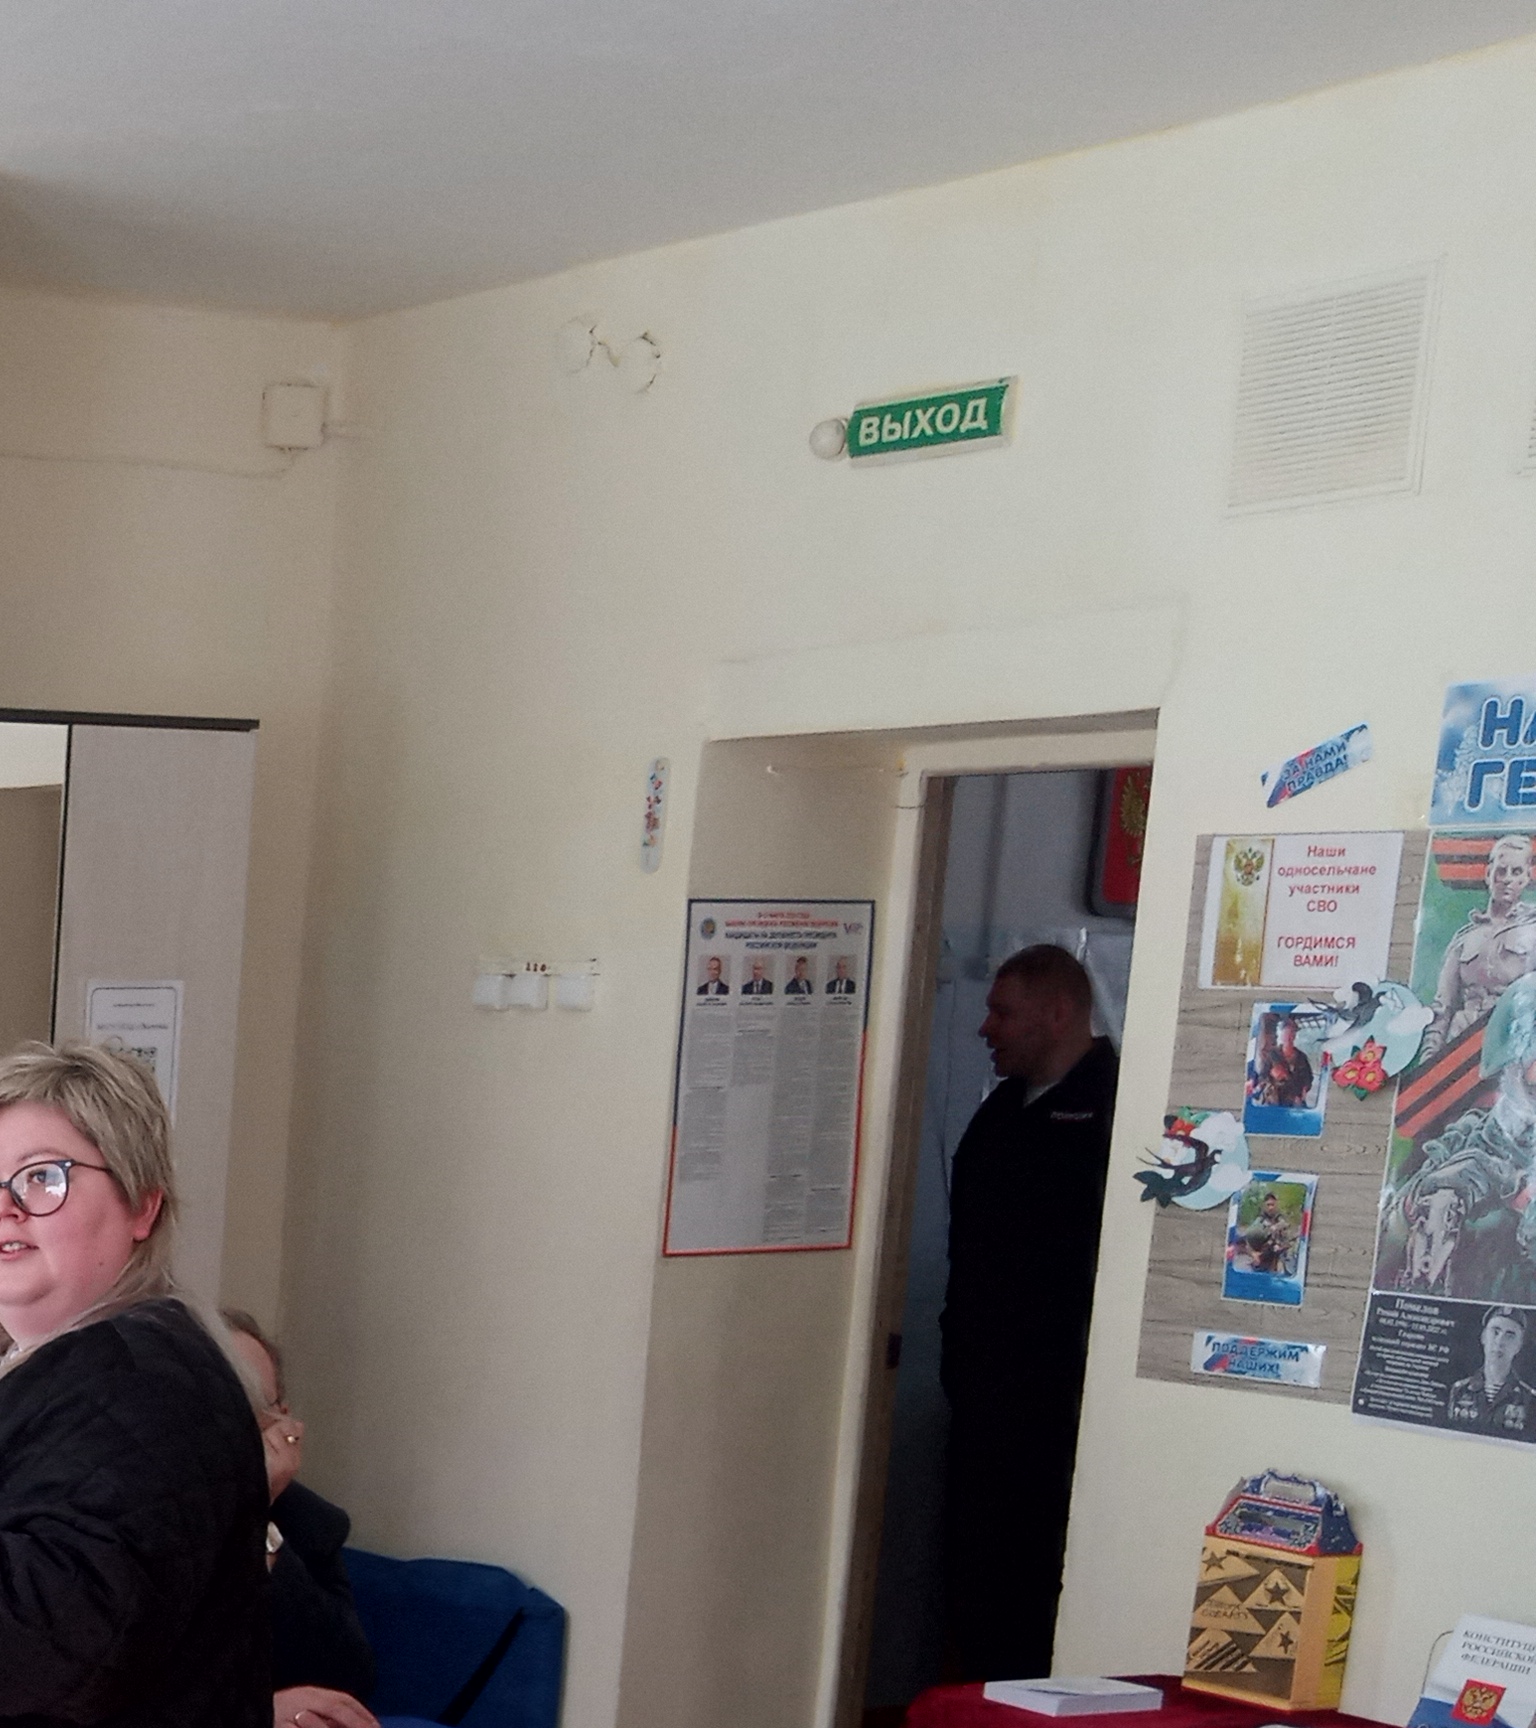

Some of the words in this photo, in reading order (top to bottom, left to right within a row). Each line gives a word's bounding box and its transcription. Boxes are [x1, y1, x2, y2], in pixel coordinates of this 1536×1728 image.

[858, 397, 989, 448] ВЫХОД
[1283, 764, 1301, 781] ЗА
[1306, 741, 1347, 766] НАМИ
[1287, 754, 1348, 792] ПРАВДА!
[1307, 845, 1346, 858] Наши
[1277, 865, 1377, 878] односельчане
[1288, 883, 1360, 898] участники
[1306, 899, 1338, 913] СВО
[1277, 935, 1356, 951] ГОРДИМСЯ
[1293, 954, 1339, 968] ВАМИ!
[1212, 1341, 1300, 1362] ПОДДЕРЖИМ
[1229, 1358, 1281, 1375] НАШИХ!
[1460, 1653, 1531, 1675] ФЕДЕРАЦИИ
